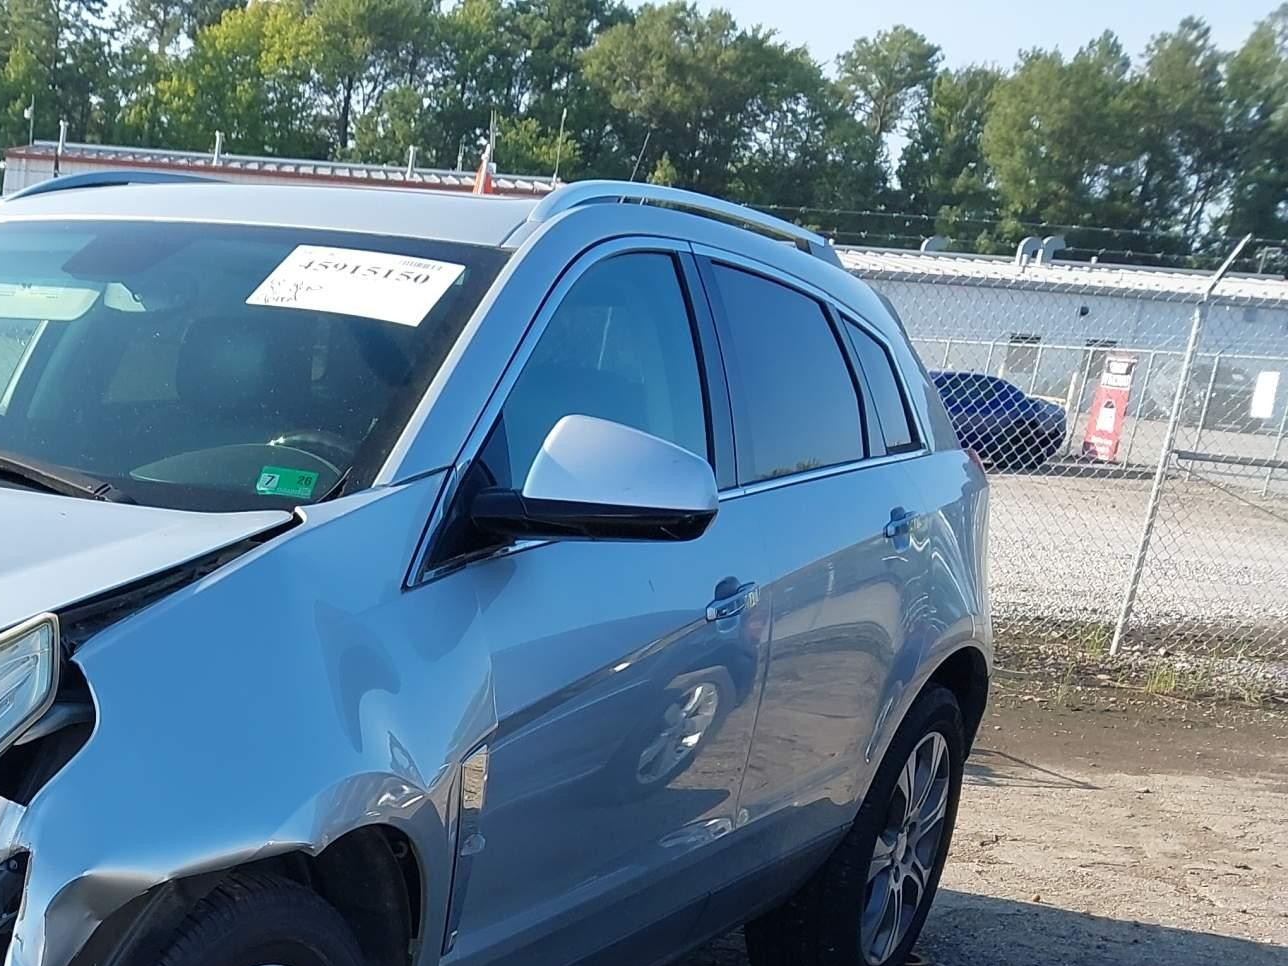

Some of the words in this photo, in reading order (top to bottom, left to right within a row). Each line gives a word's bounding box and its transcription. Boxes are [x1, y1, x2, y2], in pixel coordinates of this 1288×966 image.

[298, 260, 431, 284] 45915150
[264, 474, 275, 486] 7
[296, 475, 312, 487] 26
